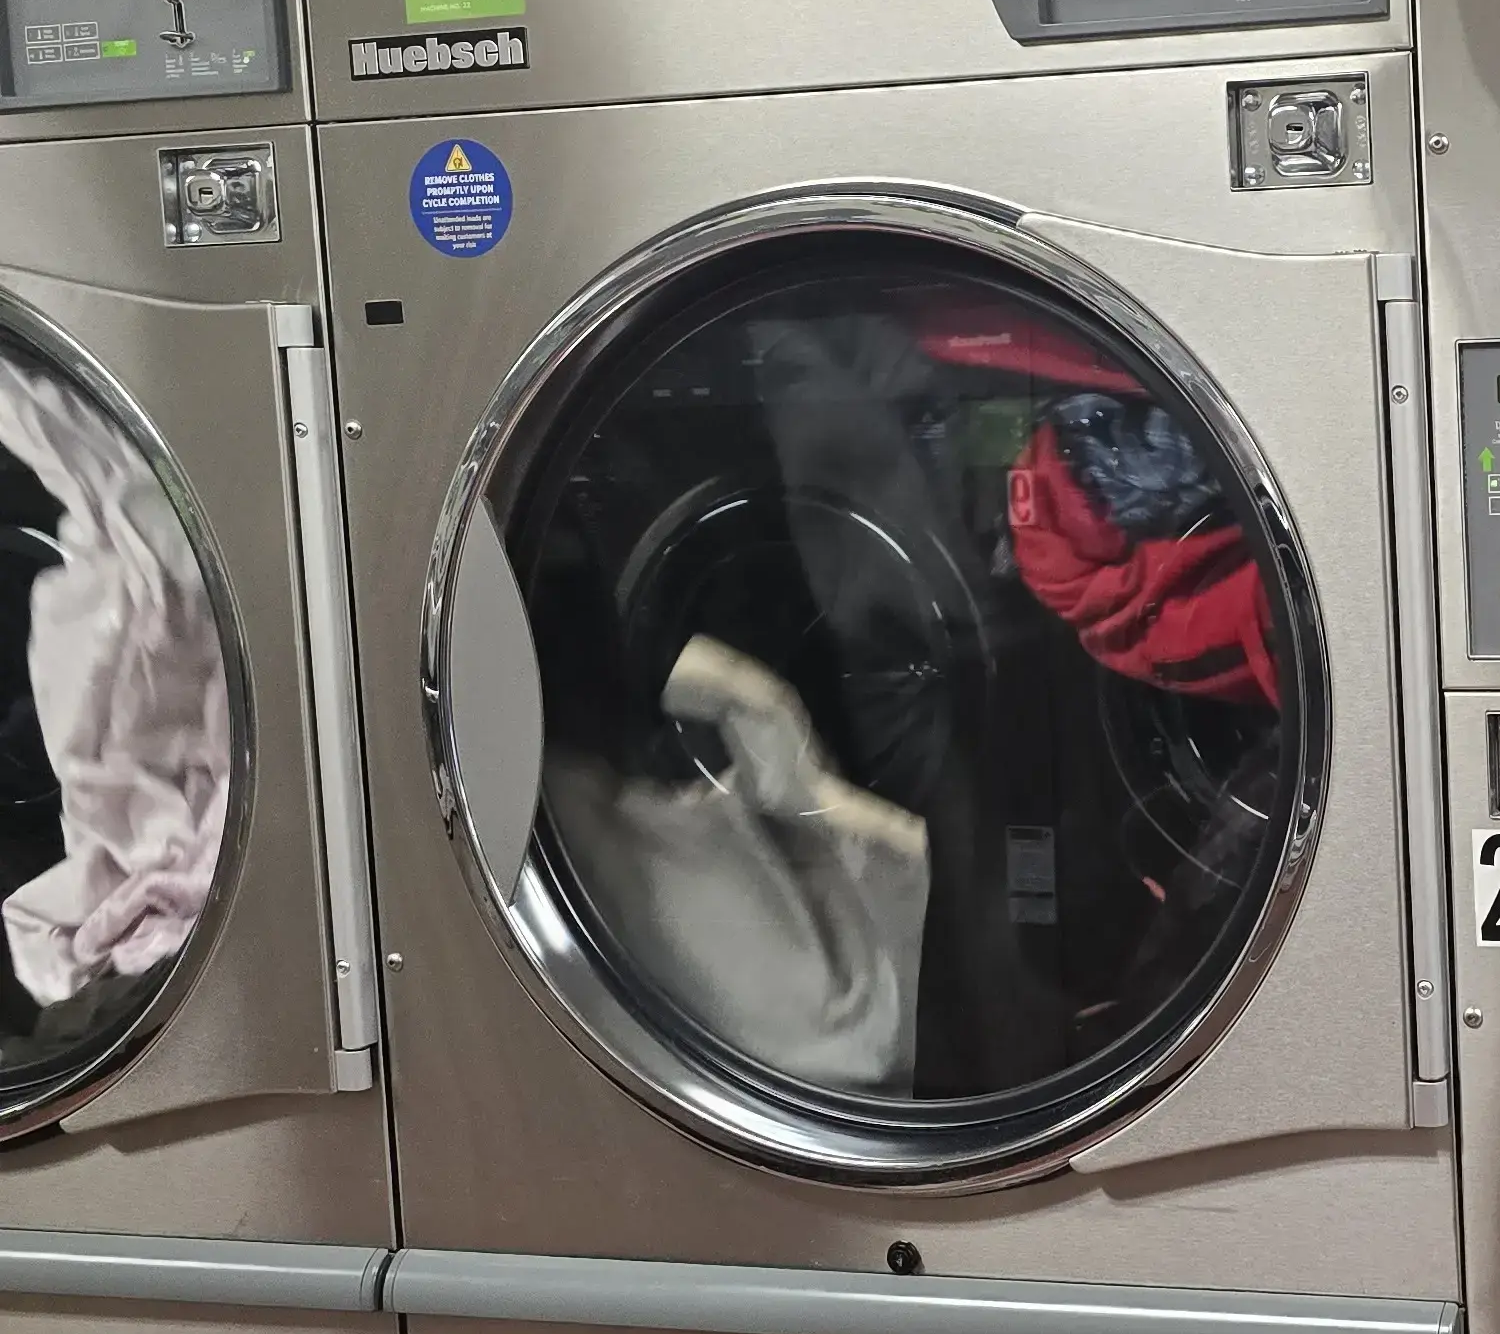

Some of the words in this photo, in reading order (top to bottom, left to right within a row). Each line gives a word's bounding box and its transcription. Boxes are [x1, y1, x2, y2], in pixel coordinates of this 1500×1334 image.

[351, 31, 524, 76] Huebsch
[425, 175, 458, 185] REMOVE
[459, 173, 495, 183] CLOTHES
[427, 186, 469, 196] PROMPTLY
[471, 184, 494, 194] UPON
[422, 198, 447, 208] CYCLE
[448, 196, 500, 206] COMPLETION
